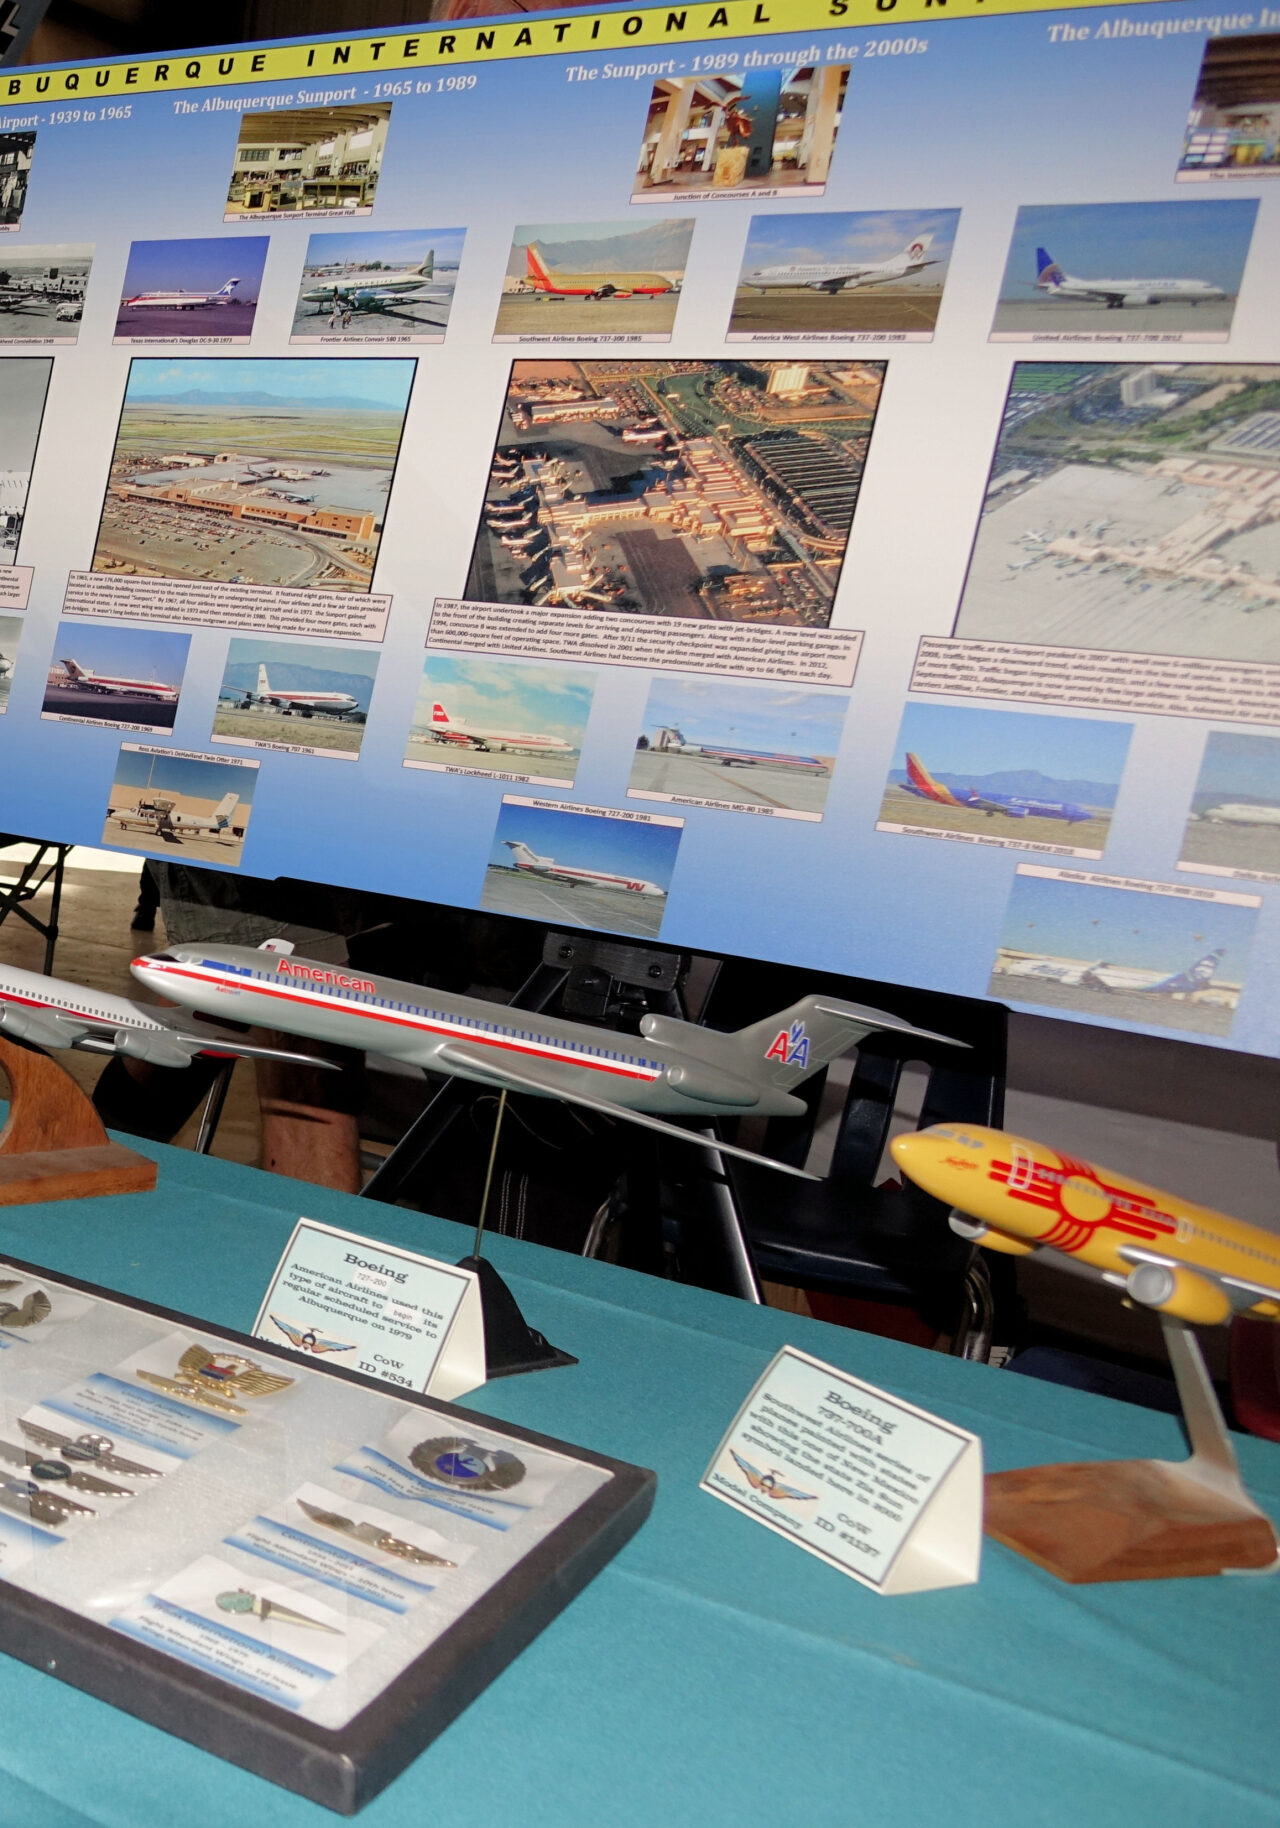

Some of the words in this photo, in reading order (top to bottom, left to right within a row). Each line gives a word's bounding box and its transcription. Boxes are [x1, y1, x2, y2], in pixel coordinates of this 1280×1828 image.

[307, 3, 770, 66] INTERNATIONAL
[1048, 22, 1089, 42] The
[1094, 10, 1254, 43] Albuquerque
[566, 65, 598, 81] The
[602, 58, 674, 82] Sunport
[692, 52, 738, 71] 1989
[743, 46, 820, 70] through
[826, 42, 859, 60] the
[864, 37, 928, 57] 2000s
[174, 99, 198, 114] The
[200, 91, 293, 115] Albuquerque
[296, 86, 356, 107] Sunport
[373, 81, 411, 97] 1965
[416, 81, 430, 93] to
[438, 75, 476, 92] 1989
[49, 110, 79, 124] 1939
[83, 110, 96, 121] to
[99, 105, 131, 120] 1965
[272, 743, 289, 751] Boeing
[464, 768, 491, 777] Lockheed
[532, 800, 558, 808] Western
[560, 803, 583, 811] Airlines
[584, 807, 606, 816] Boeing
[671, 796, 702, 805] American
[704, 800, 730, 808] Airlines
[276, 958, 376, 994] American
[764, 1030, 810, 1069] AA
[344, 1253, 408, 1284] Boeing
[358, 1273, 386, 1287] 727-200
[282, 1281, 321, 1297] regular
[324, 1296, 379, 1318] scheduled
[382, 1316, 422, 1333] service
[290, 1272, 312, 1284] type
[328, 1287, 368, 1304] aircraft
[372, 1301, 383, 1309] to
[424, 1319, 437, 1328] its
[291, 1264, 342, 1284] American
[345, 1282, 388, 1300] Airlines
[392, 1299, 418, 1310] used
[422, 1308, 443, 1320] this
[298, 1296, 368, 1324] Albuquerque
[389, 1328, 412, 1340] 1979
[358, 1361, 376, 1372] ID
[381, 1371, 412, 1388] #534
[374, 1354, 404, 1369] CoW
[824, 1391, 896, 1434] Boeing
[713, 1473, 747, 1496] Model
[749, 1495, 802, 1529] Company
[815, 1517, 835, 1532] ID
[837, 1513, 872, 1534] CoW
